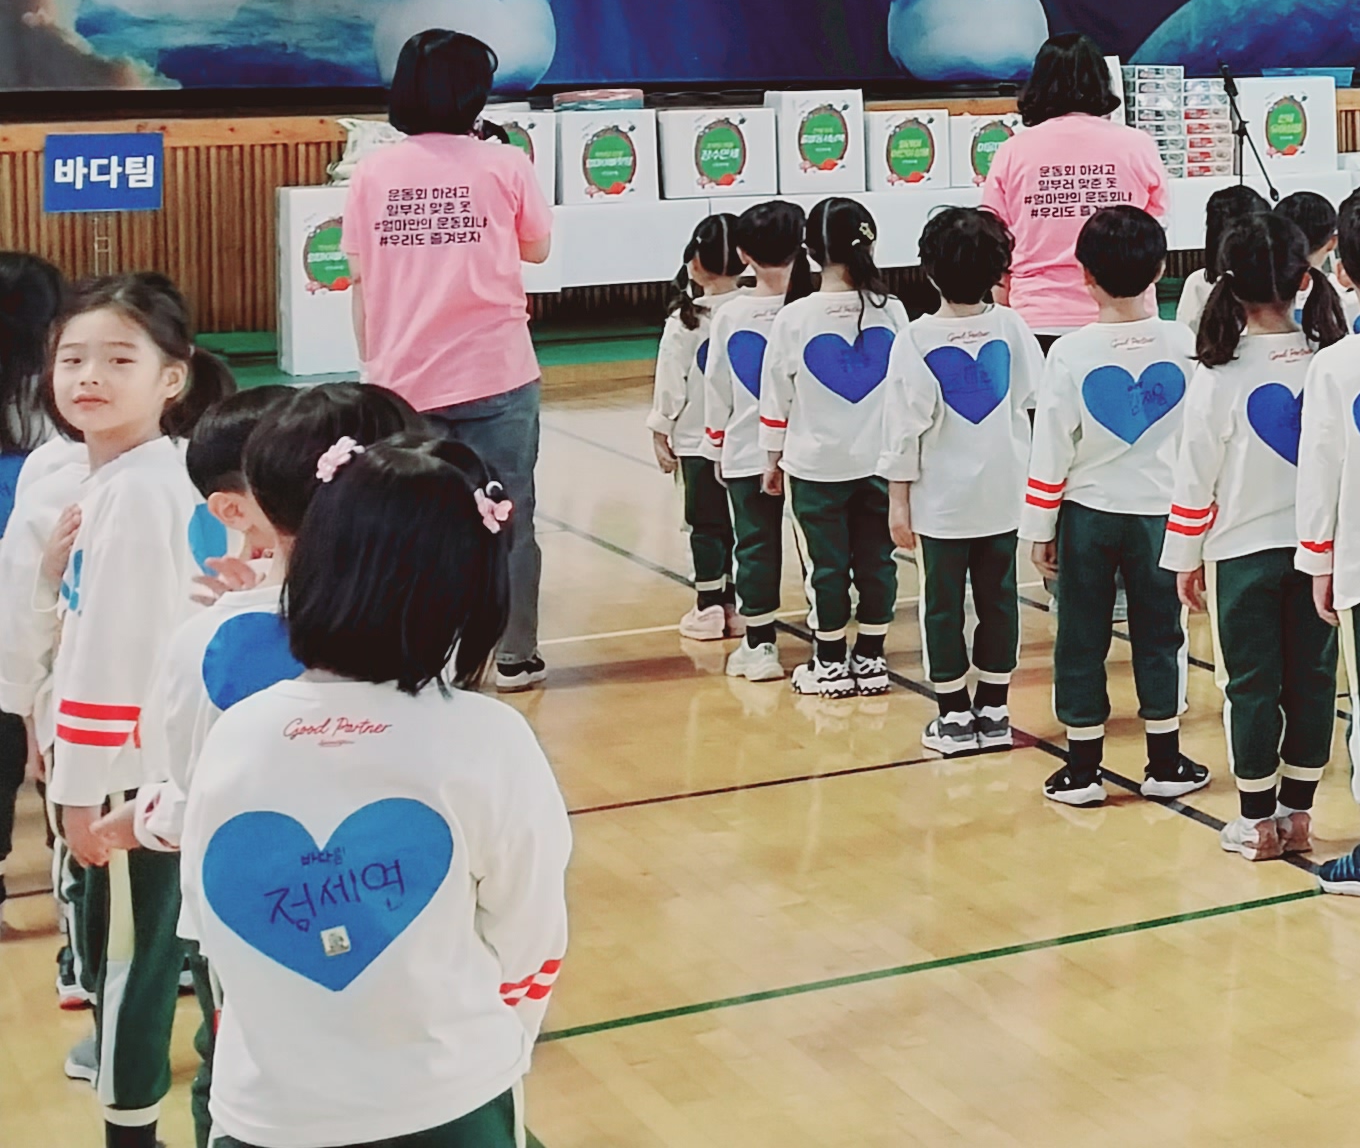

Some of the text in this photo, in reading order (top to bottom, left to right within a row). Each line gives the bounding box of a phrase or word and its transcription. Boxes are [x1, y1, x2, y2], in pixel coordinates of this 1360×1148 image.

[54, 154, 155, 190] 바다팀
[282, 717, 392, 740] Good Partner
[263, 858, 406, 933] 정세연
